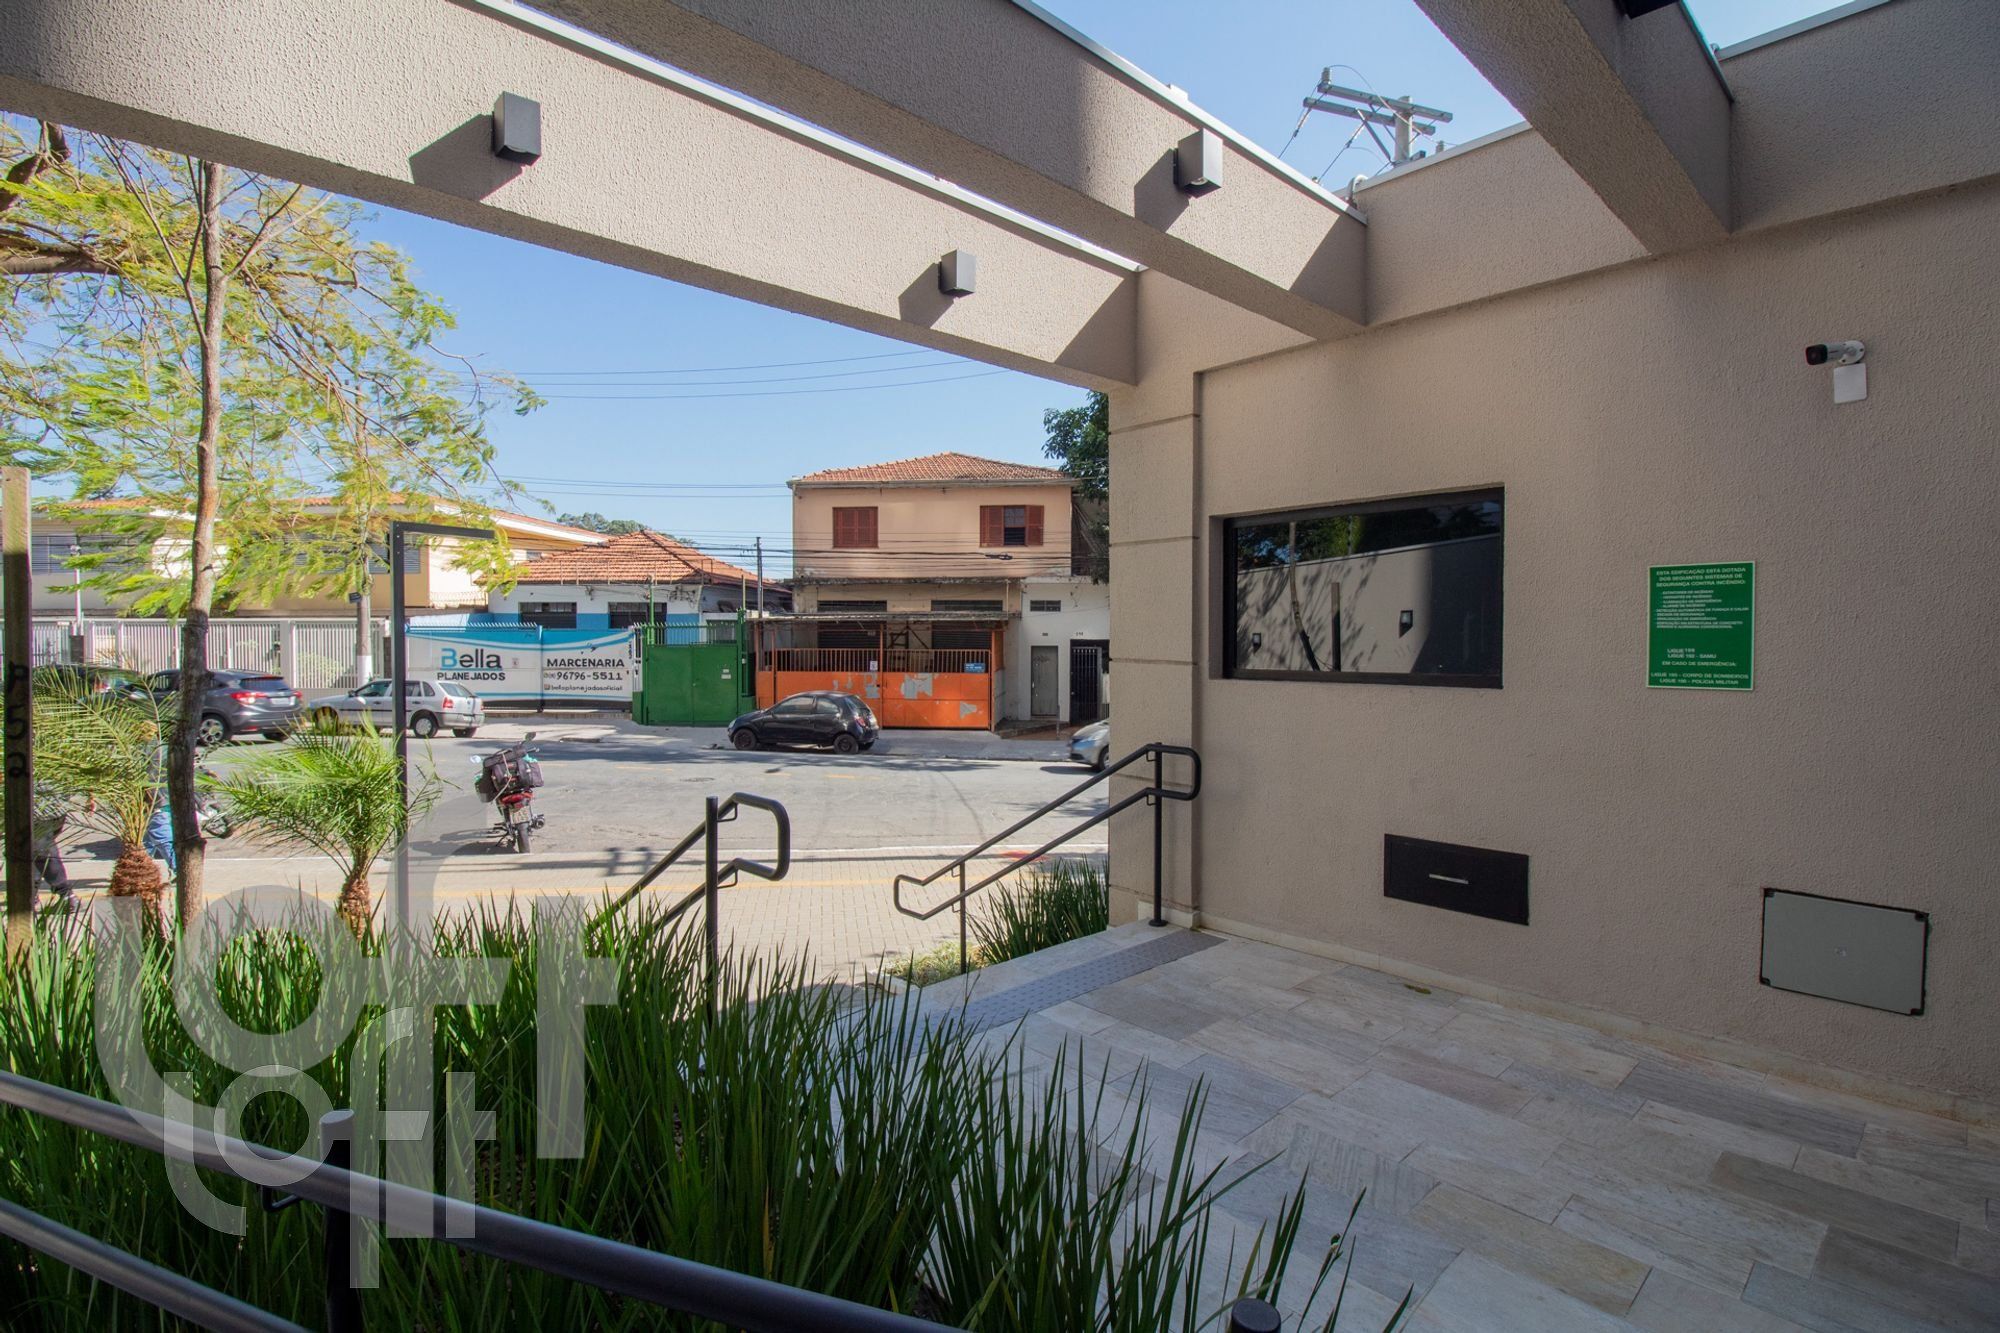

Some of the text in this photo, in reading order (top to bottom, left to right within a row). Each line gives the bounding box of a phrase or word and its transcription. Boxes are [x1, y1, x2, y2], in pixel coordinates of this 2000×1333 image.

[441, 648, 502, 668] Bella
[546, 658, 625, 667] MARCENARIA
[556, 671, 623, 681] 96796-5511
